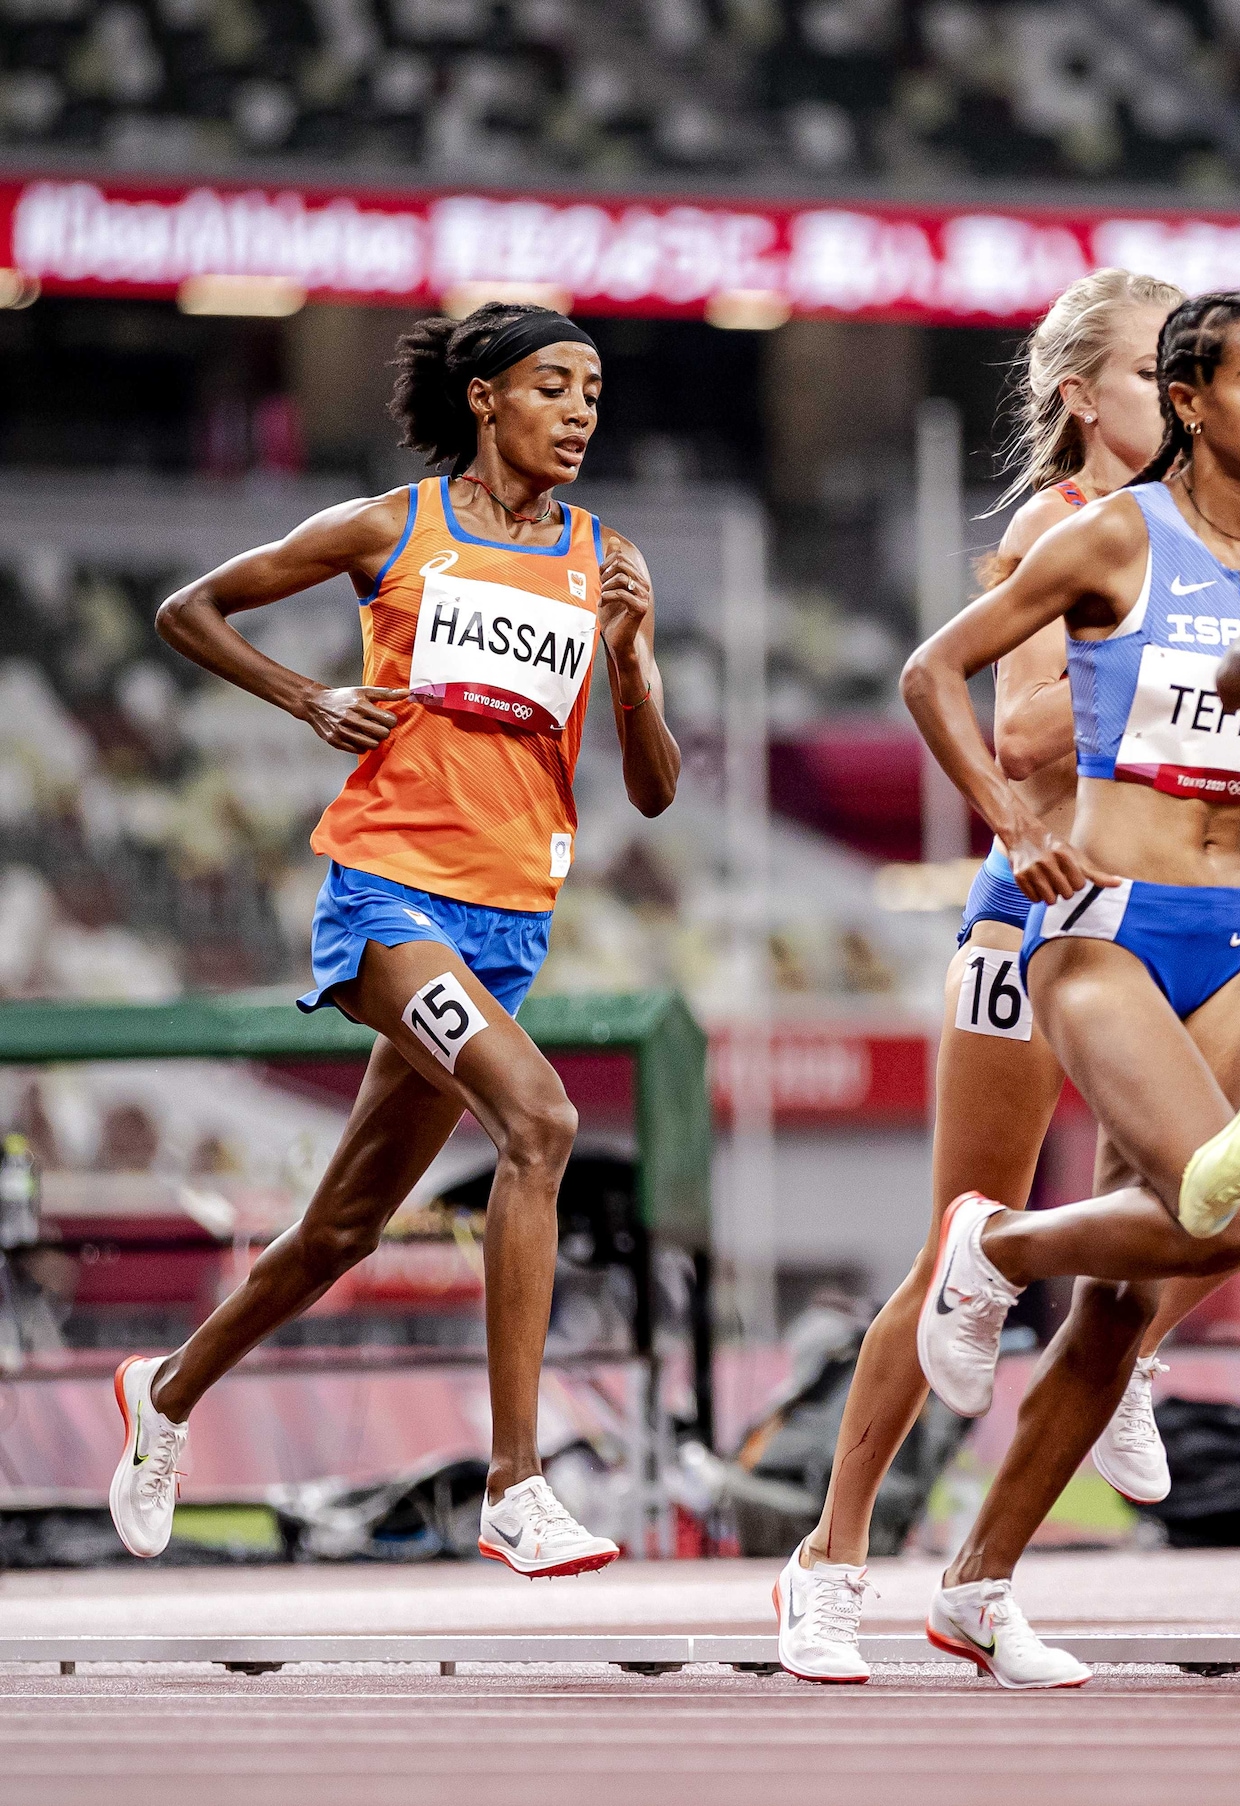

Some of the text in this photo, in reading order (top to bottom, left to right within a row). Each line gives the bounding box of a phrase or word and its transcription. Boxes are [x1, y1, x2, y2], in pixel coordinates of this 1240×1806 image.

[430, 604, 585, 679] HASSAN
[463, 691, 511, 712] TOKYO 2020
[411, 983, 470, 1058] 15
[969, 956, 1022, 1030] 16
